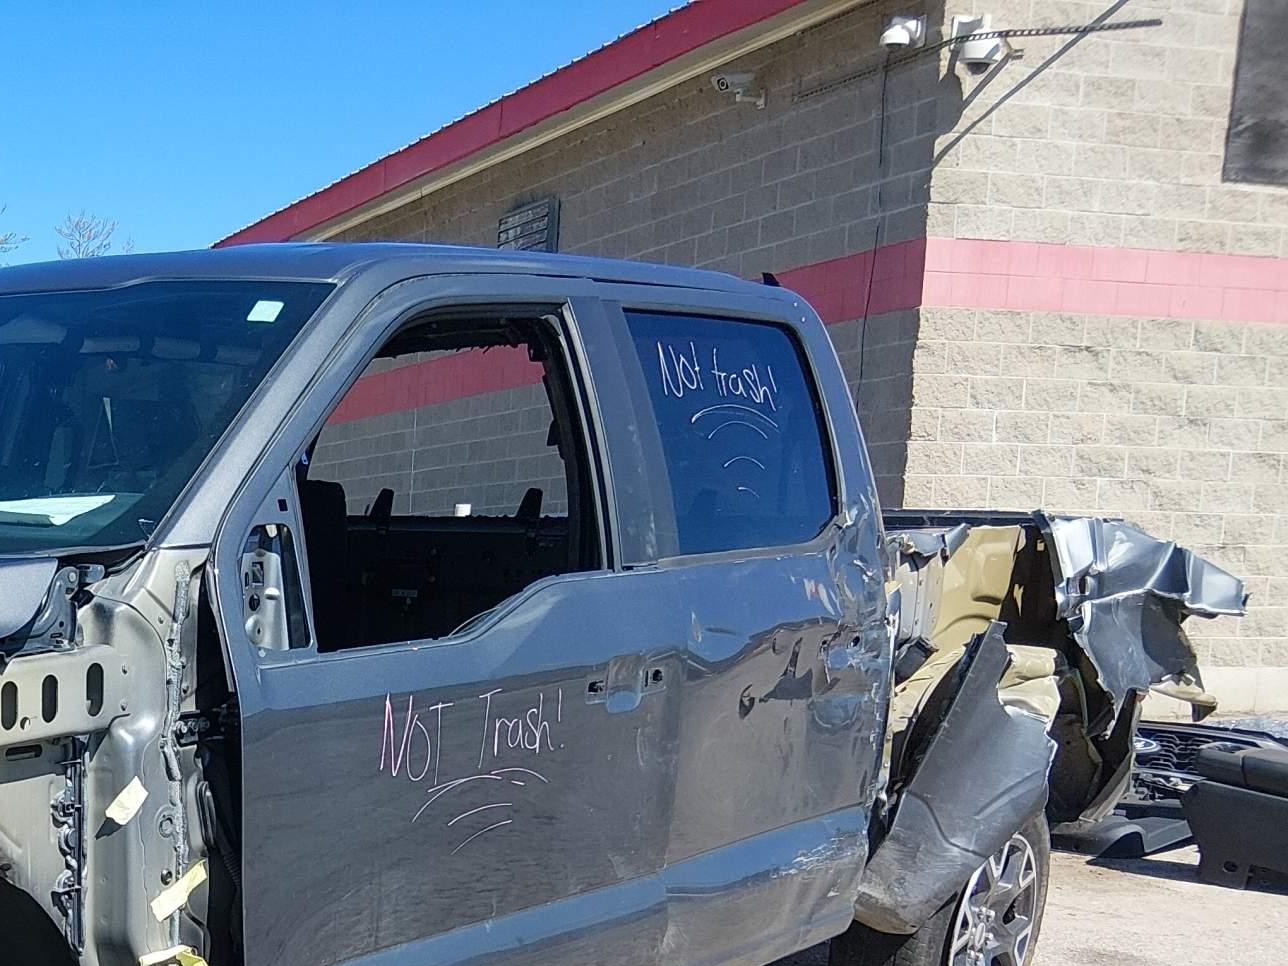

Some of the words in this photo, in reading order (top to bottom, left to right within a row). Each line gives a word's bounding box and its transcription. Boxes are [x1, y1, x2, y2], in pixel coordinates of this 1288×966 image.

[657, 340, 704, 398] Not
[380, 691, 454, 786] NOT
[478, 687, 565, 770] Trash!
